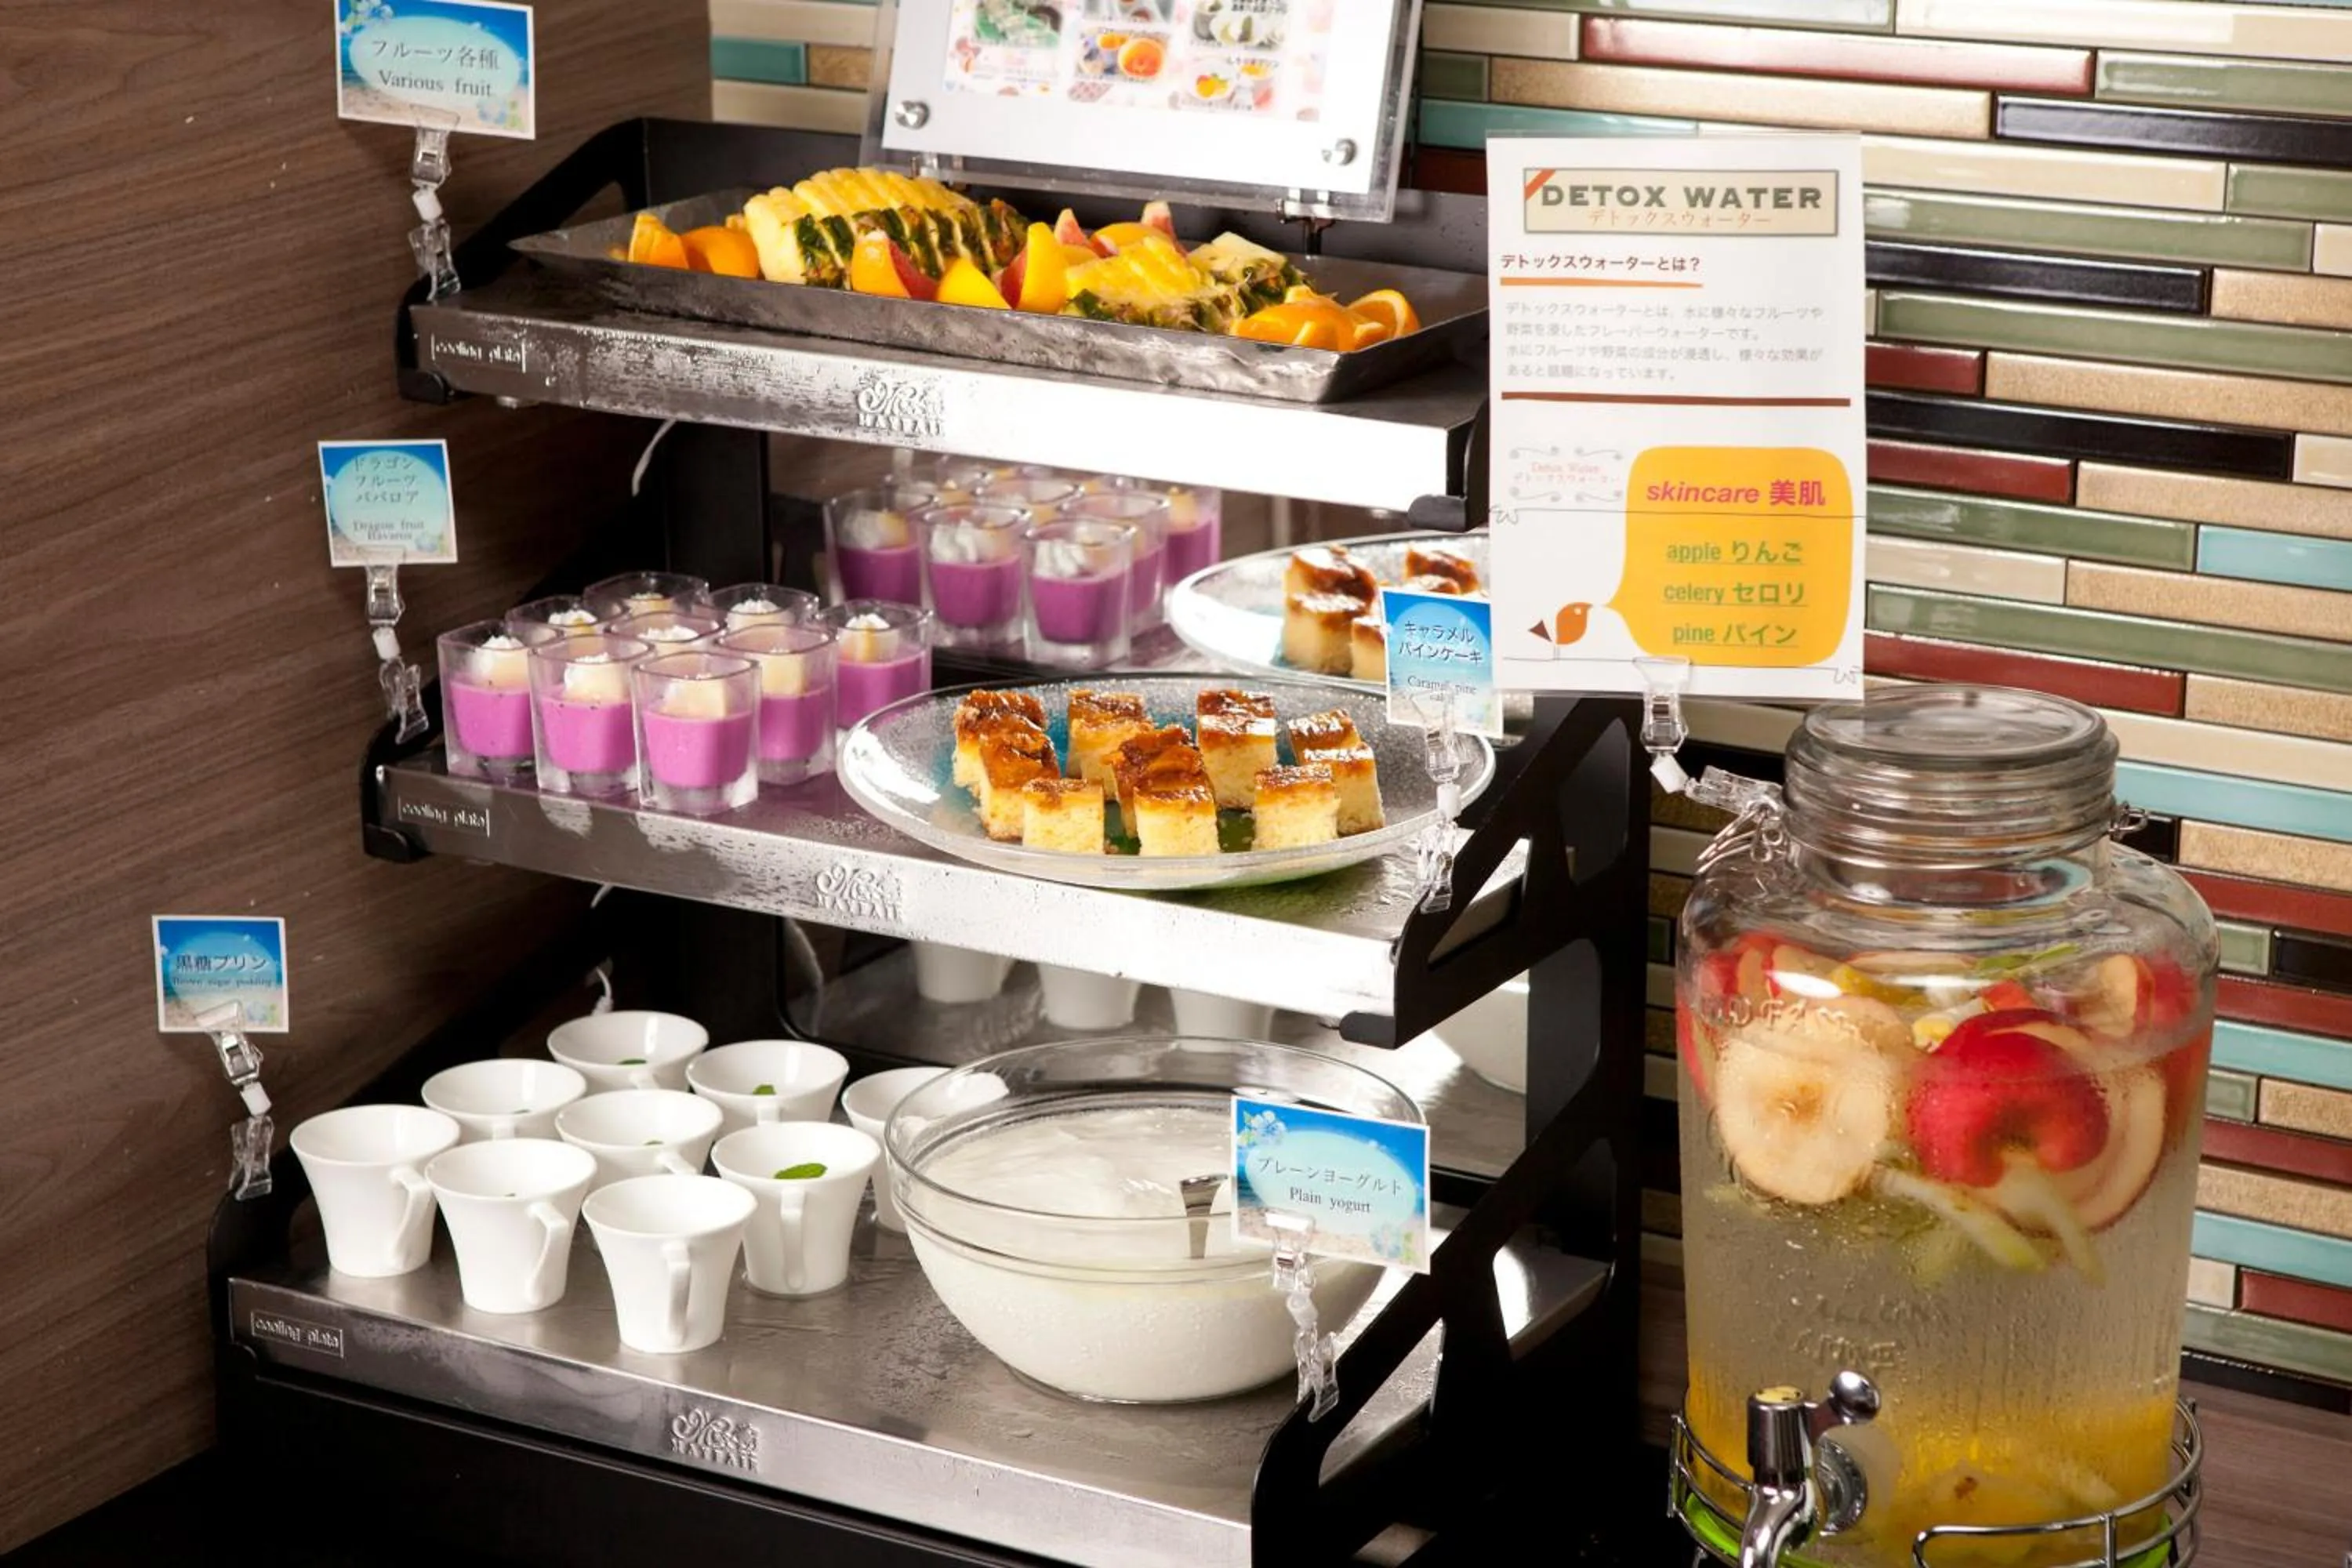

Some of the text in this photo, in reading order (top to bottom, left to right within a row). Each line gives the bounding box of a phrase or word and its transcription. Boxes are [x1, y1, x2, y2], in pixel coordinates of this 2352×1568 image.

[372, 39, 500, 71] フルーツ各種
[378, 69, 492, 97] Various fruit
[1541, 184, 1823, 210] DETOX WATER
[1588, 209, 1772, 228] デトックスウォーター
[355, 474, 418, 488] フルーツ
[1646, 479, 1826, 506] skincare 美肌
[1666, 539, 1803, 563] apple りんご
[1663, 583, 1805, 604] celery セロリ
[1404, 620, 1475, 643] キャラメル
[1671, 623, 1797, 645] pine パイン
[1398, 641, 1483, 666] パインケーキ
[1258, 1156, 1402, 1199] プレーンヨーグルト
[1290, 1186, 1371, 1214] Plain yogurt
